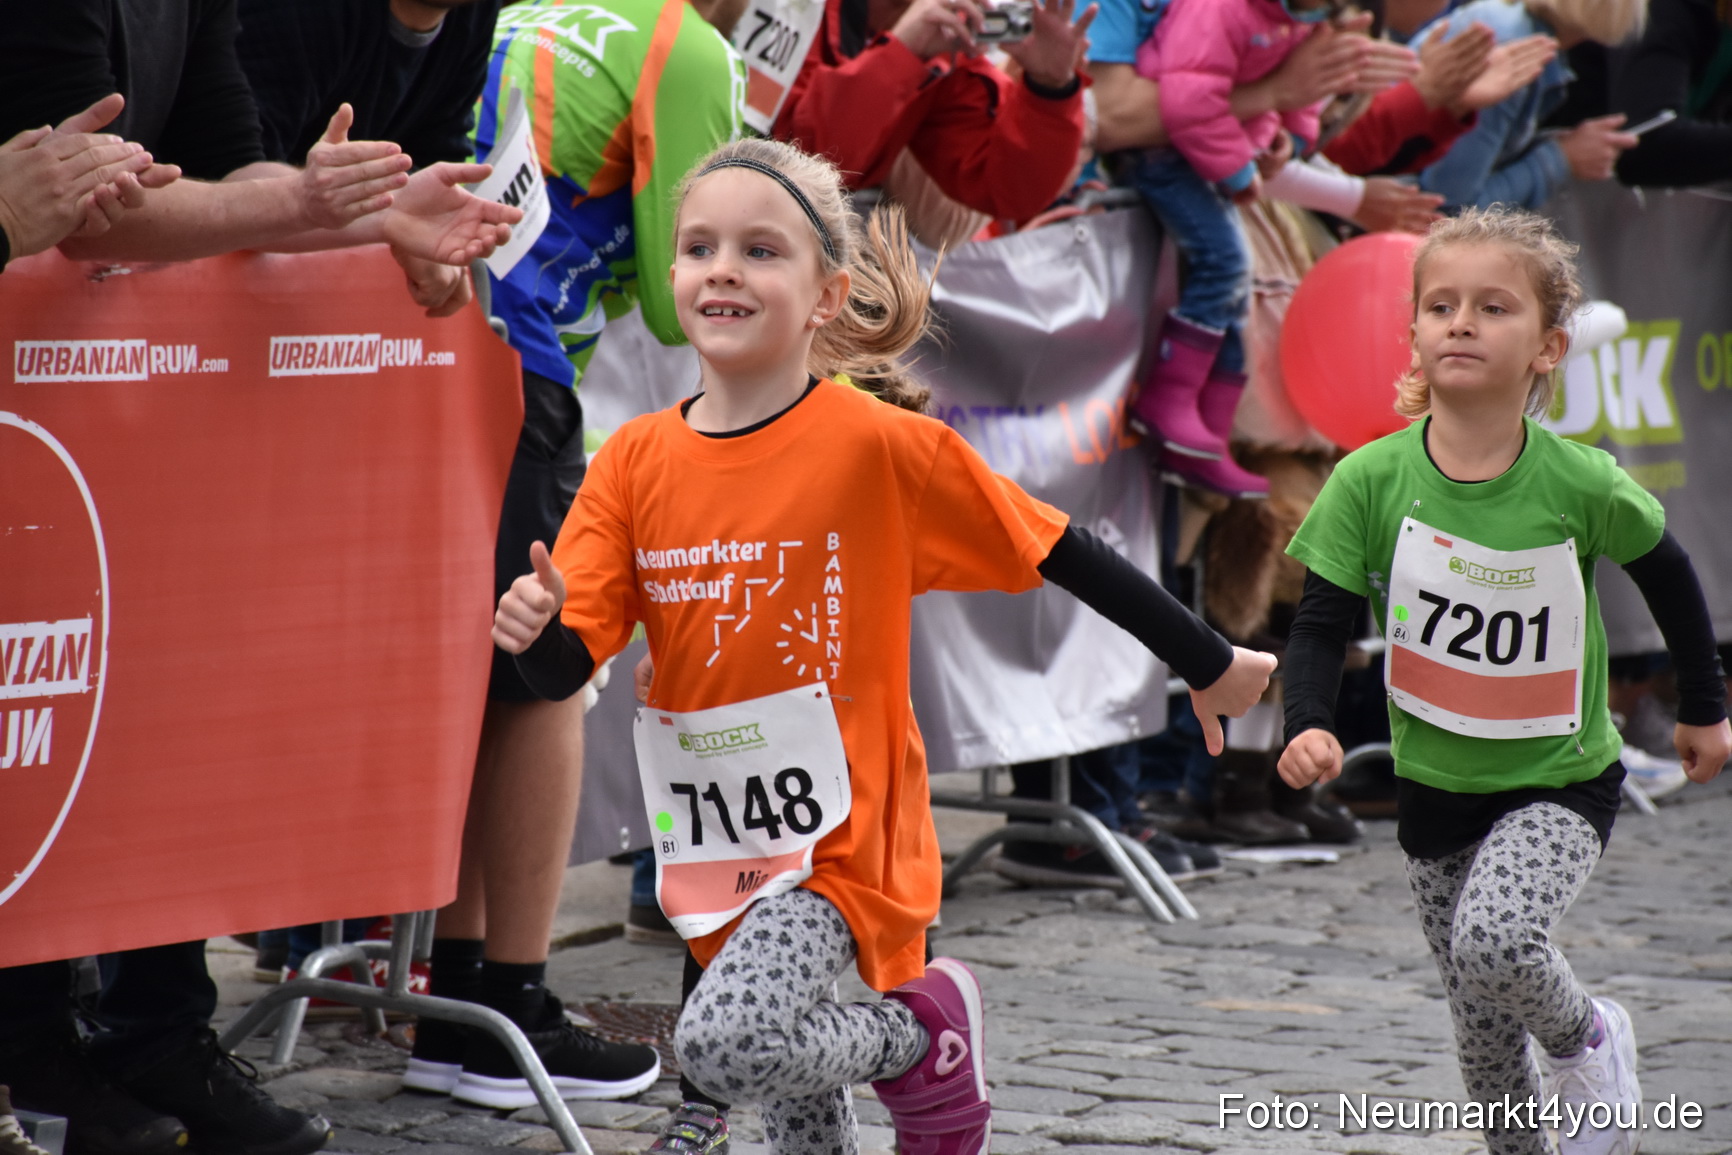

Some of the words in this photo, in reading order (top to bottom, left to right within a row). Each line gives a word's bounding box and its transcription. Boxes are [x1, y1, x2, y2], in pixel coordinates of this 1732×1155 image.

[522, 32, 597, 78] concepts
[636, 539, 767, 571] Neumarkter
[1468, 562, 1536, 584] BOCK
[1419, 589, 1550, 666] 7201
[691, 723, 765, 752] BOCK
[670, 767, 823, 846] 7148
[662, 841, 675, 853] B1
